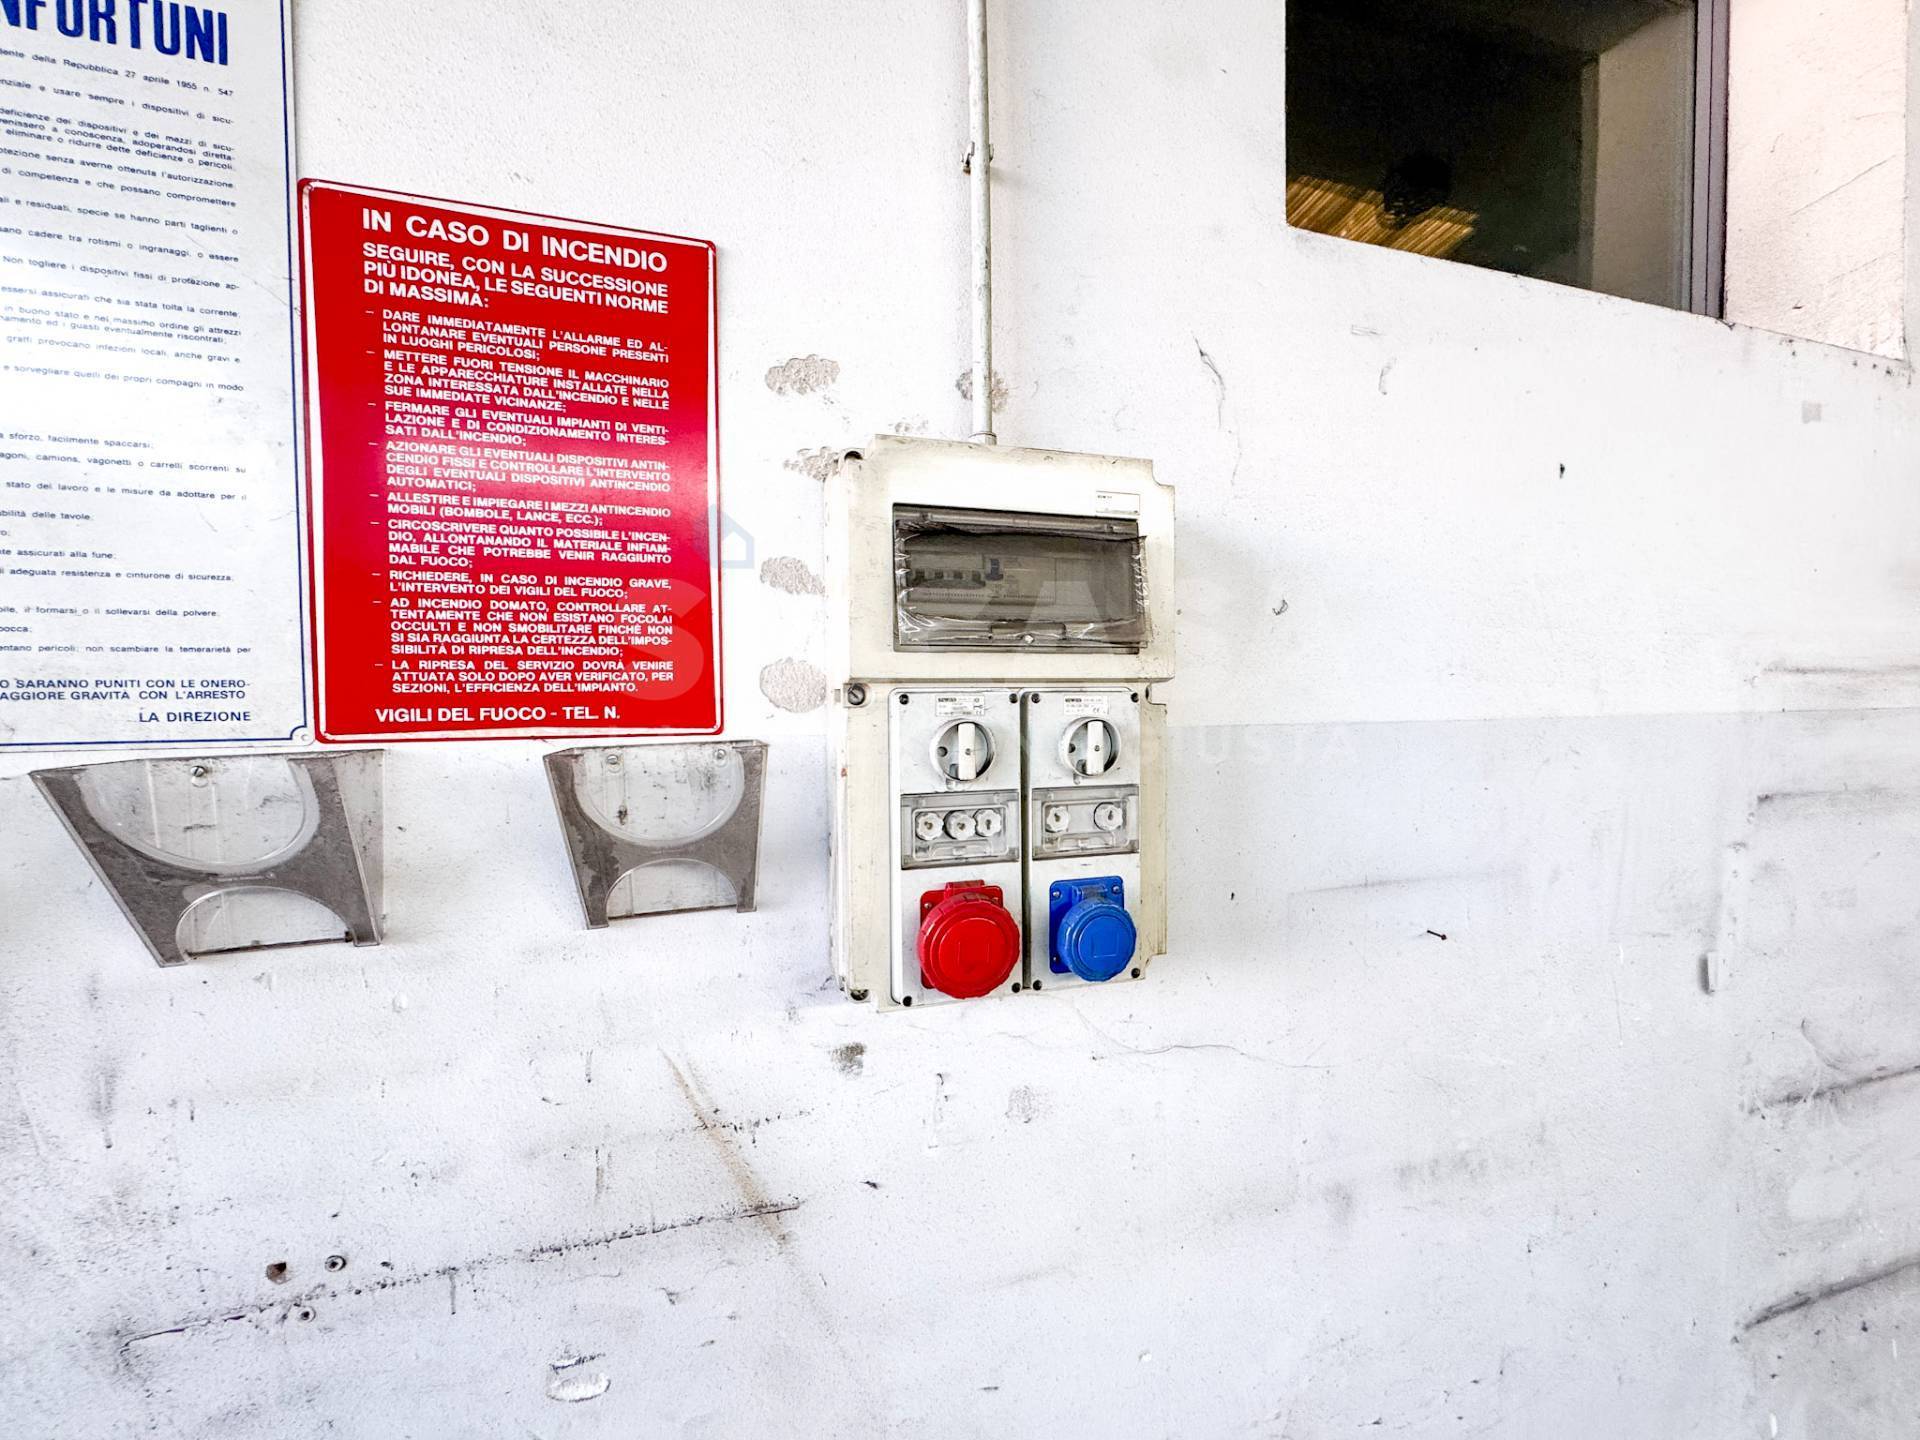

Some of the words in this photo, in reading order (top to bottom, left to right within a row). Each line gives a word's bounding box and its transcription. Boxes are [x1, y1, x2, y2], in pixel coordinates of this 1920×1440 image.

[31, 54, 56, 64] della
[63, 58, 118, 75] Repubblica
[125, 70, 136, 78] 27
[143, 75, 169, 85] aprile
[218, 88, 233, 96] 547
[53, 88, 81, 97] usare
[87, 94, 124, 105] sempre
[141, 103, 189, 116] dispositivi
[212, 116, 233, 124] sicu-
[17, 170, 79, 184] competenza
[96, 181, 115, 189] che
[120, 185, 160, 197] possano
[166, 192, 236, 207] compromettere
[363, 208, 391, 232] IN
[405, 215, 489, 246] CASO
[502, 229, 529, 252] DI
[542, 235, 667, 272] INCENDIO
[363, 242, 454, 270] SEGUIRE,
[461, 256, 504, 275] CON
[511, 262, 535, 279] LA
[540, 267, 668, 297] SUCCESSIONE
[364, 260, 396, 278] PIÙ
[400, 265, 480, 291] IDONEA,
[484, 276, 507, 293] LE
[510, 280, 601, 305] SEGUENTI
[605, 293, 668, 314] NORME
[364, 278, 384, 294] DI
[389, 281, 488, 307] MASSIMA:
[382, 308, 420, 322] DARE
[427, 314, 546, 338] IMMEDIATAMENTE
[552, 330, 621, 346] L'ALLARME
[627, 338, 642, 349] ED
[649, 341, 667, 352] AL-
[383, 321, 466, 340] LONTANARE
[472, 331, 543, 349] EVENTUALI
[549, 340, 606, 356] PERSONE
[612, 348, 668, 363] PRESENTI
[383, 333, 397, 343] IN
[401, 334, 453, 350] LUOGHI
[457, 341, 539, 361] PERICOLOSI;
[384, 349, 447, 365] METTERE
[453, 356, 493, 370] FUORI
[499, 361, 563, 377] TENSIONE
[568, 369, 579, 379] IL
[584, 371, 669, 388] MACCHINARIO
[384, 360, 392, 371] E
[398, 362, 415, 373] LE
[421, 365, 548, 387] APPARECCHIATURE
[553, 378, 627, 395] INSTALLATE
[631, 386, 669, 399] NELLA
[384, 373, 423, 386] ZONA
[428, 377, 519, 395] INTERESSATA
[523, 386, 618, 405] DALL'INCENDIO
[621, 396, 629, 406] E
[633, 397, 669, 410] NELLE
[384, 384, 412, 397] SUE
[416, 387, 490, 404] IMMEDIATE
[494, 395, 566, 412] VICINANZE;
[9, 568, 56, 576] adeguata
[126, 572, 170, 581] cinturone
[389, 569, 472, 583] RICHIEDERE,
[480, 573, 493, 583] IN
[500, 574, 537, 584] CASO
[544, 575, 557, 585] DI
[564, 576, 623, 587] INCENDIO
[629, 578, 671, 589] GRAVE,
[390, 597, 409, 607] AD
[417, 598, 482, 609] INCENDIO
[489, 599, 549, 612] DOMATO,
[556, 601, 645, 612] CONTROLLARE
[652, 604, 671, 613] AT-
[390, 609, 480, 620] TENTAMENTE
[486, 611, 513, 621] CHE
[519, 612, 547, 622] NON
[553, 612, 614, 623] ESISTANO
[620, 614, 672, 625] FOCOLAI
[390, 620, 450, 631] OCCULTI
[458, 622, 466, 632] E
[473, 622, 502, 632] NON
[508, 622, 592, 634] SMOBILITARE
[647, 625, 672, 634] NON
[391, 632, 404, 642] SI
[407, 632, 430, 642] SIA
[432, 633, 510, 644] RAGGIUNTA
[512, 634, 529, 644] LA
[531, 634, 596, 644] CERTEZZA
[598, 635, 672, 645] DELL'IMPOS-
[451, 644, 465, 654] DI
[468, 645, 523, 655] RIPRESA
[526, 645, 623, 657] DELL'INCENDIO;
[391, 660, 409, 669] LA
[418, 660, 475, 670] RIPRESA
[484, 660, 508, 670] DEL
[517, 660, 575, 670] SERVIZIO
[632, 661, 672, 670] VENIRE
[392, 671, 455, 681] ATTUATA
[458, 671, 495, 681] SOLO
[498, 671, 535, 681] DOPO
[539, 671, 571, 681] AVER
[574, 671, 648, 681] VERIFICATO,
[651, 672, 673, 680] PER
[15, 680, 88, 688] SARANNO
[95, 679, 140, 688] PUNITI
[146, 679, 174, 688] CON
[181, 679, 194, 687] LE
[200, 679, 249, 687] ONERO-
[139, 690, 167, 700] CON
[176, 690, 245, 699] L'ARRESTO
[392, 683, 450, 694] SEZIONI,
[454, 682, 540, 693] L'EFFICIENZA
[543, 682, 637, 692] DELL'IMPIANTO.
[139, 712, 159, 722] LA
[166, 711, 250, 722] DIREZIONE
[375, 708, 432, 722] VIGILI
[437, 707, 474, 721] DEL
[479, 706, 546, 721] FUOCO
[604, 706, 620, 719] N.
